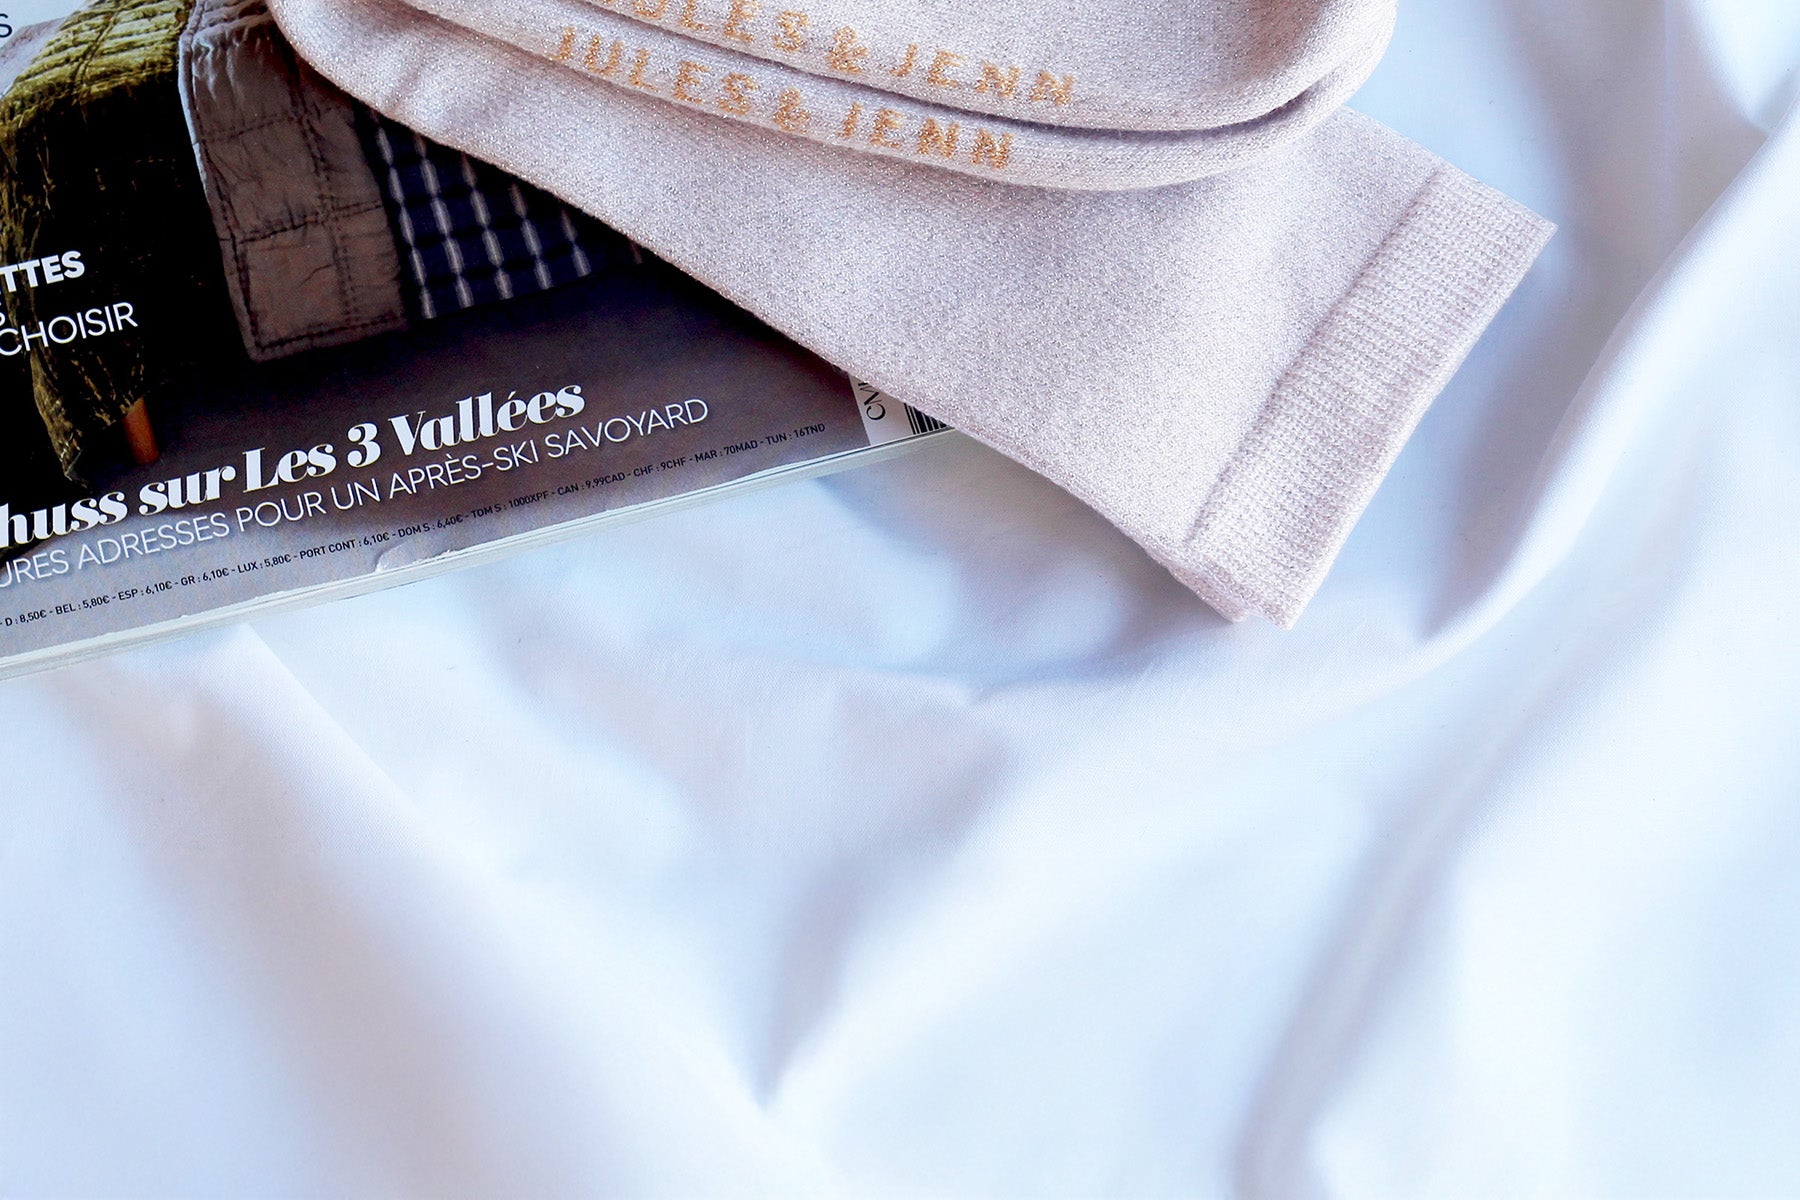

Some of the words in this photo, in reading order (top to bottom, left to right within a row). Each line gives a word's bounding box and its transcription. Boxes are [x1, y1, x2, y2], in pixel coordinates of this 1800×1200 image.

[549, 25, 757, 117] JULES
[772, 86, 811, 135] &
[826, 25, 868, 75] &
[889, 42, 1075, 106] JENN
[77, 511, 231, 571] ADRESSES
[235, 491, 328, 533] POUR
[330, 478, 381, 511] UN
[388, 439, 540, 501] APRÈS-SKI
[544, 397, 710, 460] SAVOYARD
[139, 464, 237, 516] sur
[242, 442, 337, 493] Les
[346, 421, 382, 468] 3
[387, 383, 586, 456] Vallées
[19, 608, 48, 625] 8,50€
[54, 602, 77, 616] BEL
[82, 594, 111, 610] 5,80€
[117, 588, 139, 602] ESP
[145, 580, 173, 595] 6,10€
[180, 575, 197, 587] GR
[202, 567, 230, 583] 6,10€
[236, 560, 259, 574] LUX
[263, 553, 292, 569] 5,80€
[299, 544, 327, 560] PORT
[327, 538, 357, 555] CONT
[362, 531, 390, 547] 6,10€
[397, 524, 422, 539] DOM
[436, 513, 464, 530] 6,40€
[470, 505, 494, 520] TOM
[508, 490, 549, 509] 1000XPF
[556, 482, 580, 497] CAN
[633, 464, 654, 478] CHF
[660, 456, 687, 472] 9CHF
[694, 449, 718, 463] MAR
[723, 439, 759, 456] 70MAD
[765, 432, 788, 446] TUN
